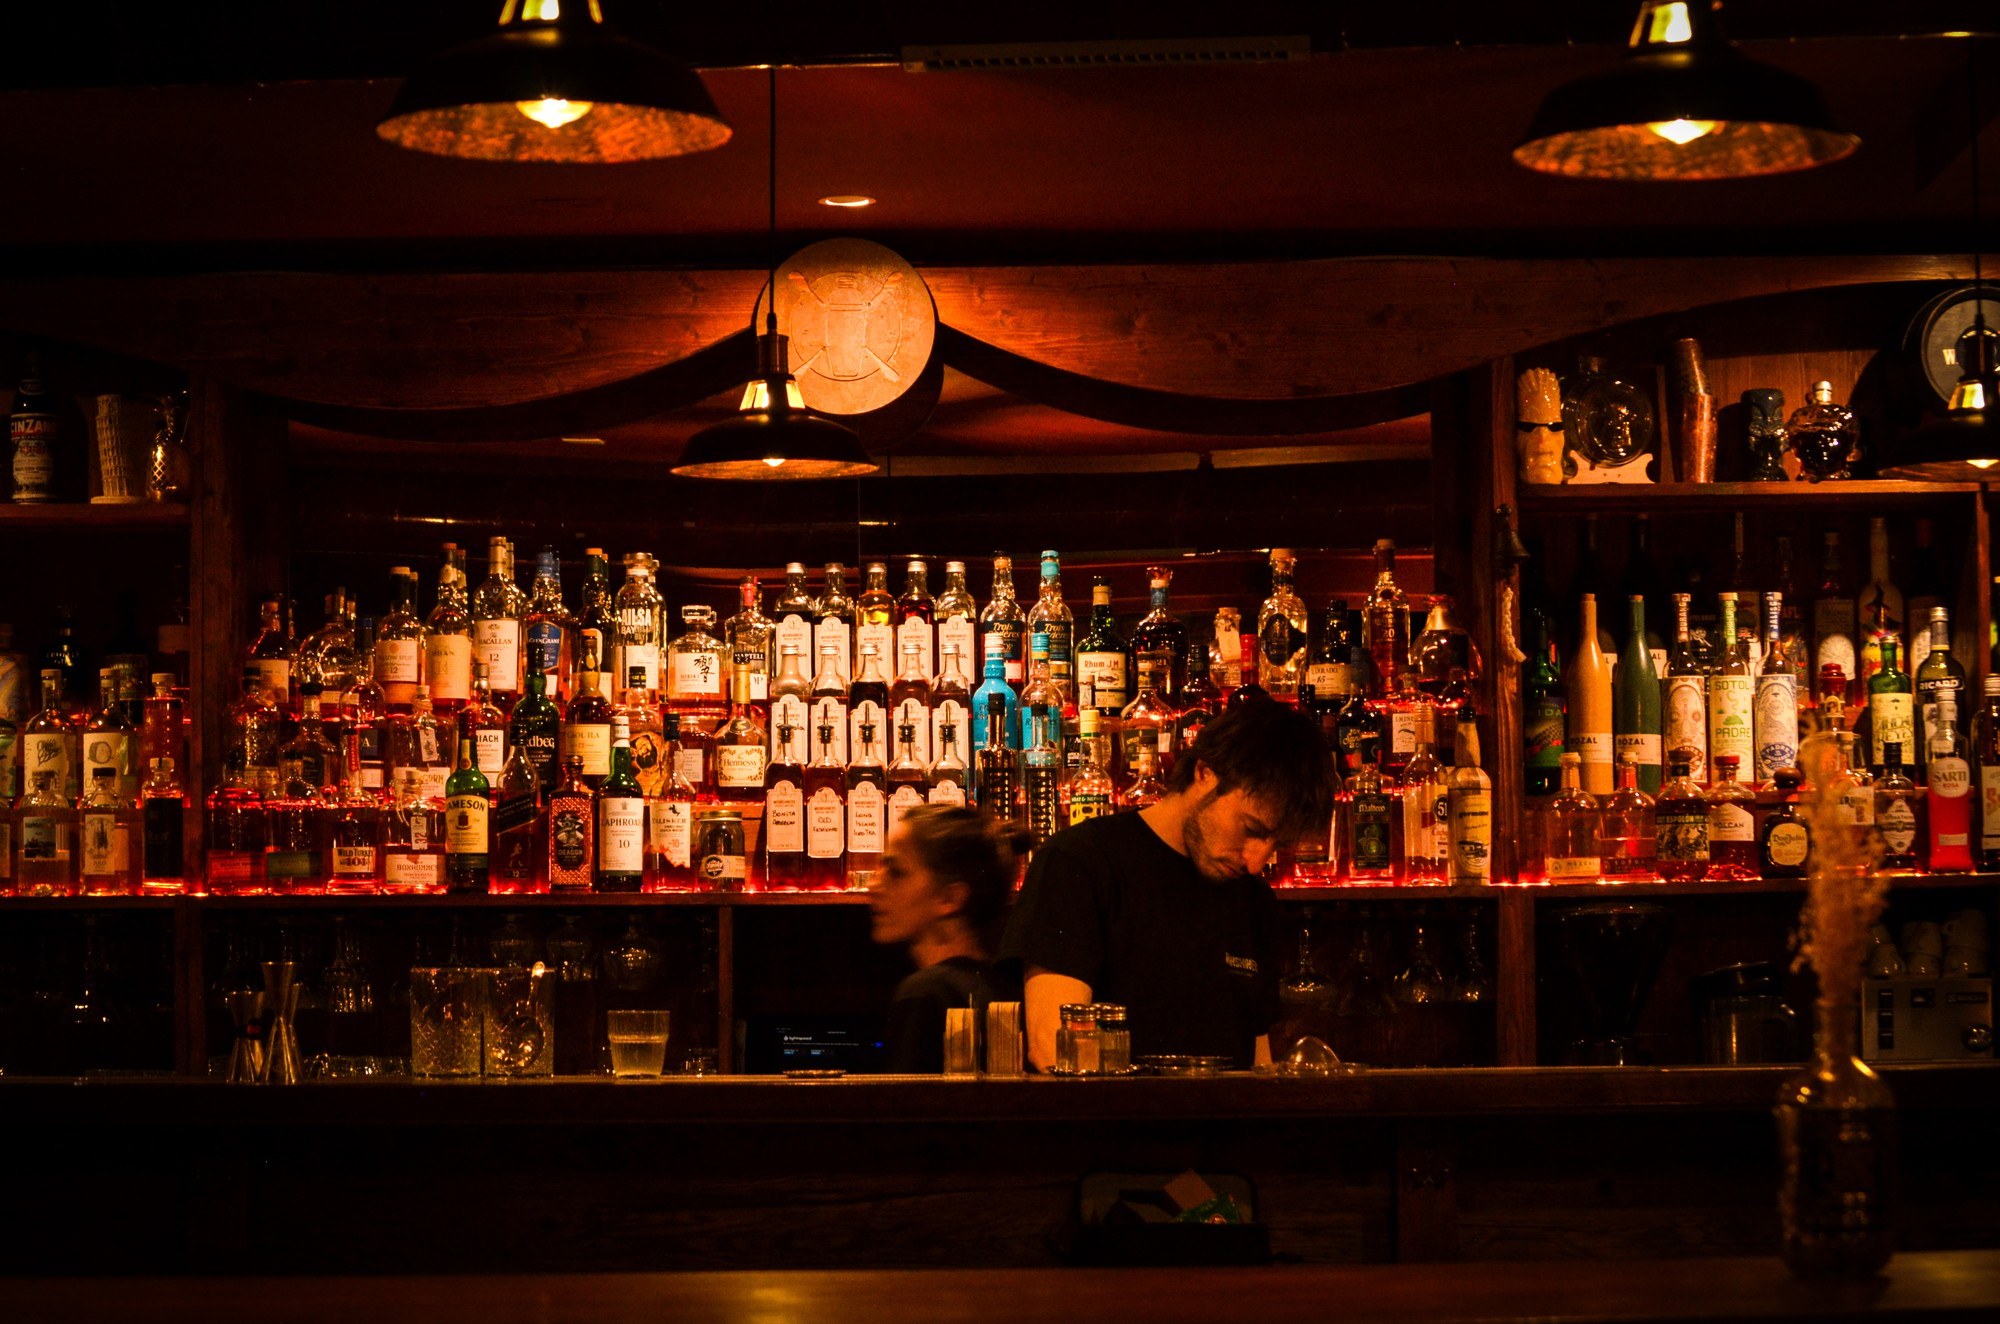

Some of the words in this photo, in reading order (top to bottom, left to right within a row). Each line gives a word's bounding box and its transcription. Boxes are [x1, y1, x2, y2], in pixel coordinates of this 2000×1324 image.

[622, 608, 651, 626] AILSA
[621, 626, 636, 634] BAY
[993, 622, 1013, 631] Trois
[1044, 623, 1064, 632] Trois
[489, 653, 499, 661] 12
[1085, 660, 1105, 668] Rhum
[1715, 681, 1750, 690] SOTOL
[1919, 679, 1959, 690] RICARD
[1182, 727, 1198, 738] Hav
[1716, 728, 1750, 738] PADRE
[526, 735, 555, 749] dbeg
[1617, 737, 1645, 745] BOZAL
[723, 759, 757, 768] Hennessy
[1934, 771, 1967, 782] SARTI
[448, 799, 486, 811] AMESON
[619, 840, 631, 848] 10
